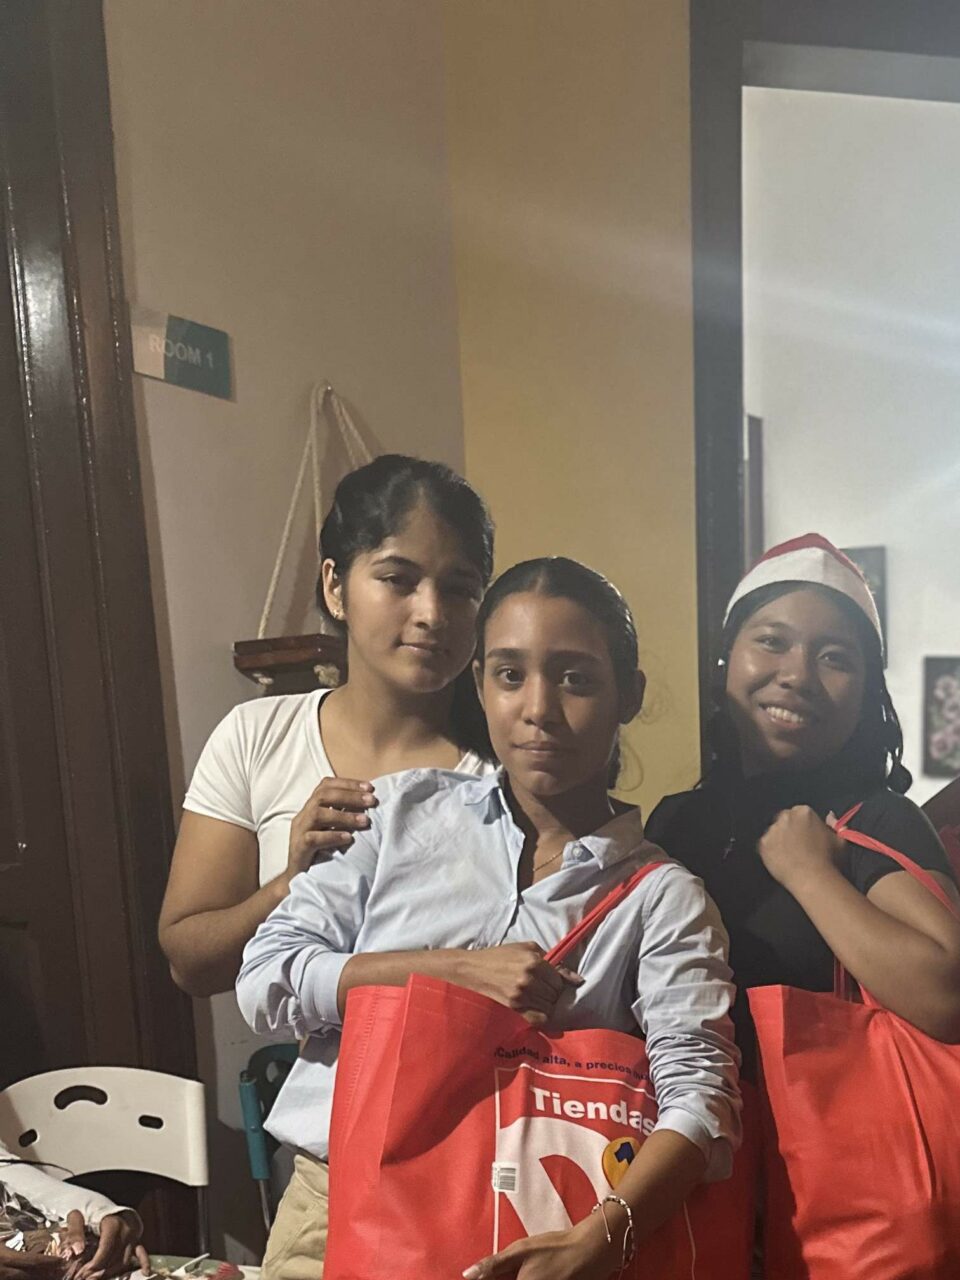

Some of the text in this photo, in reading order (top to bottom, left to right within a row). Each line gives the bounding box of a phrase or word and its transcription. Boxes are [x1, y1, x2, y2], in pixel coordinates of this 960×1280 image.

[149, 334, 214, 370] ROOM 1
[542, 1054, 571, 1067] alta,
[574, 1061, 583, 1069] a
[530, 1086, 656, 1137] Tiendas
